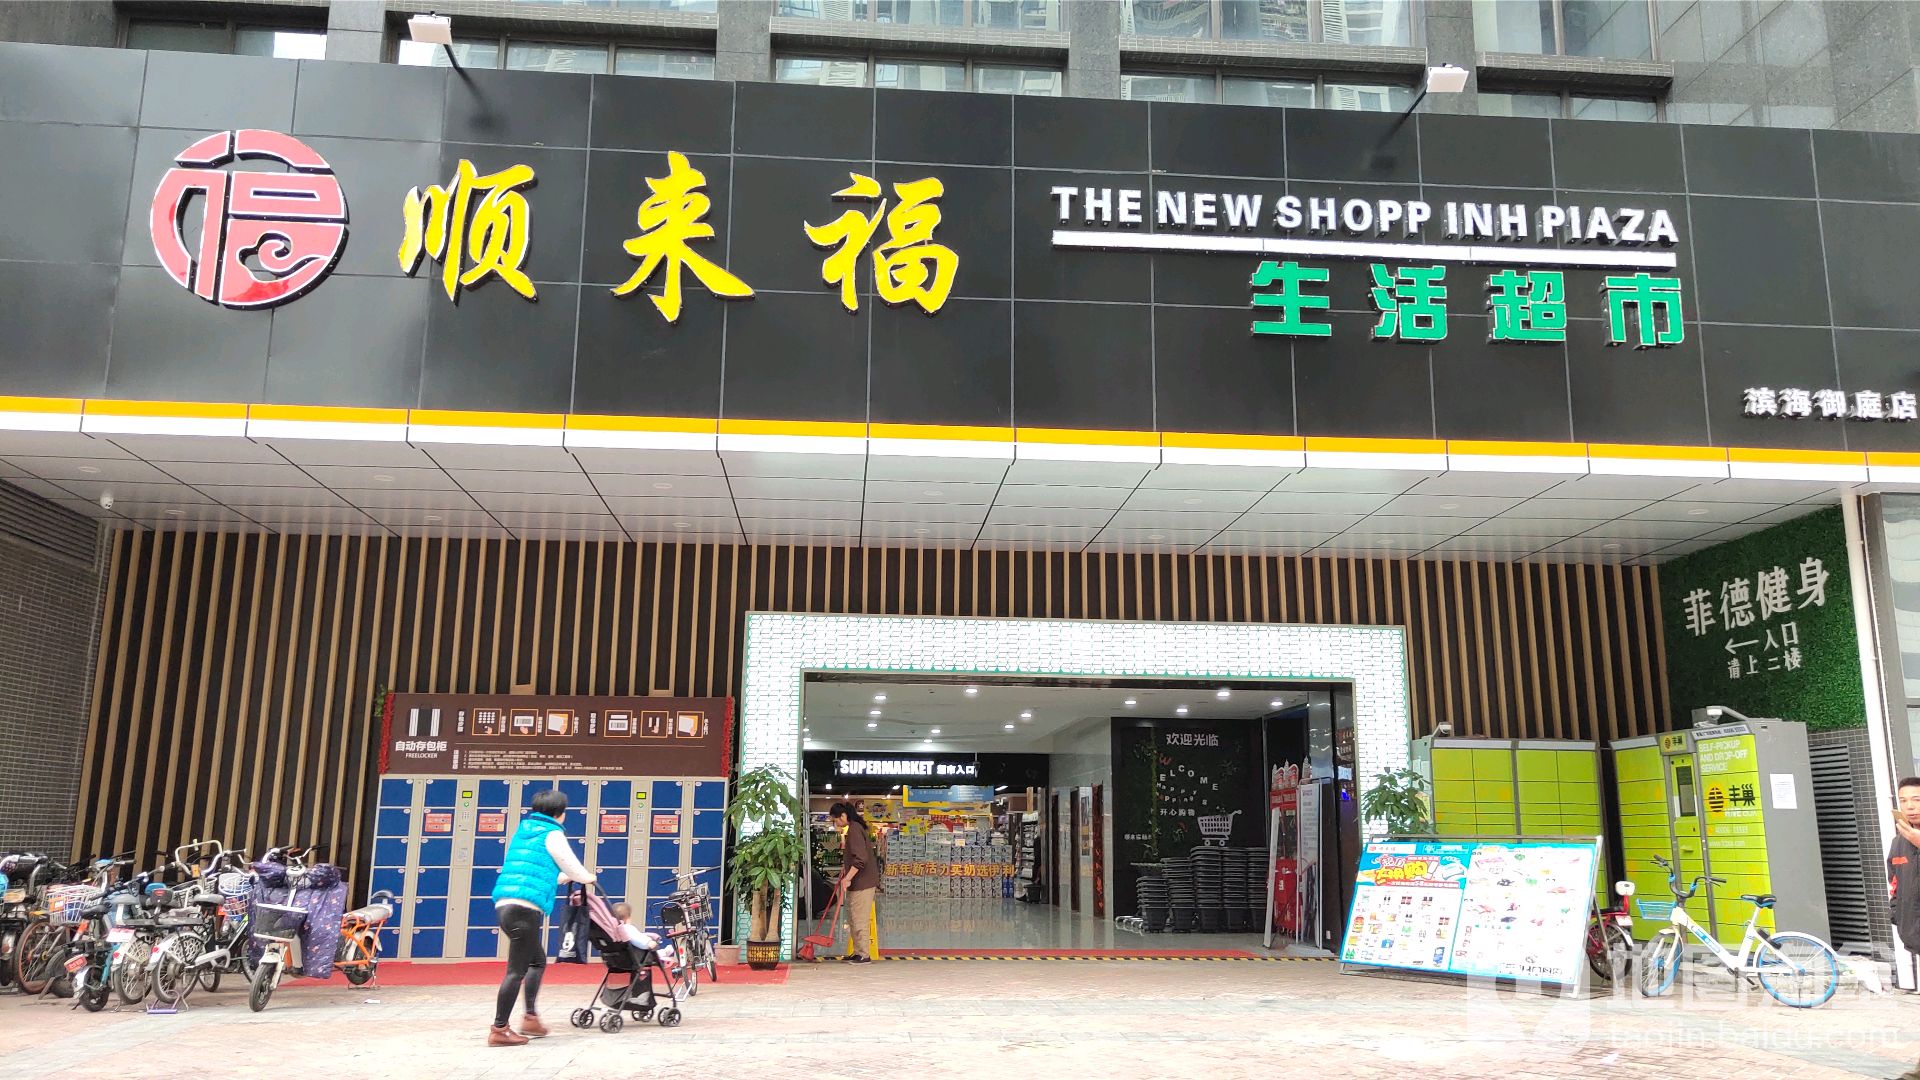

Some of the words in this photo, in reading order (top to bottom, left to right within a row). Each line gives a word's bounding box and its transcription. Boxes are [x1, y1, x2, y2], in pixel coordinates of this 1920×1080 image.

[1052, 186, 1140, 227] THE
[1157, 191, 1263, 230] NEW
[1276, 194, 1432, 237] SHOPP
[1446, 201, 1529, 241] INH
[399, 151, 959, 323] 顺来福
[1250, 260, 1684, 348] 生活超市
[1743, 387, 1917, 421] 滨海御庭店
[1682, 557, 1829, 636] 菲德健身
[1764, 621, 1799, 651] 入口
[1727, 647, 1802, 679] 请上二楼
[395, 740, 447, 752] 自动存包柜
[1166, 733, 1219, 747] 欢迎光临
[839, 759, 935, 775] SUPERMARKET
[1728, 783, 1756, 807] 丰巢
